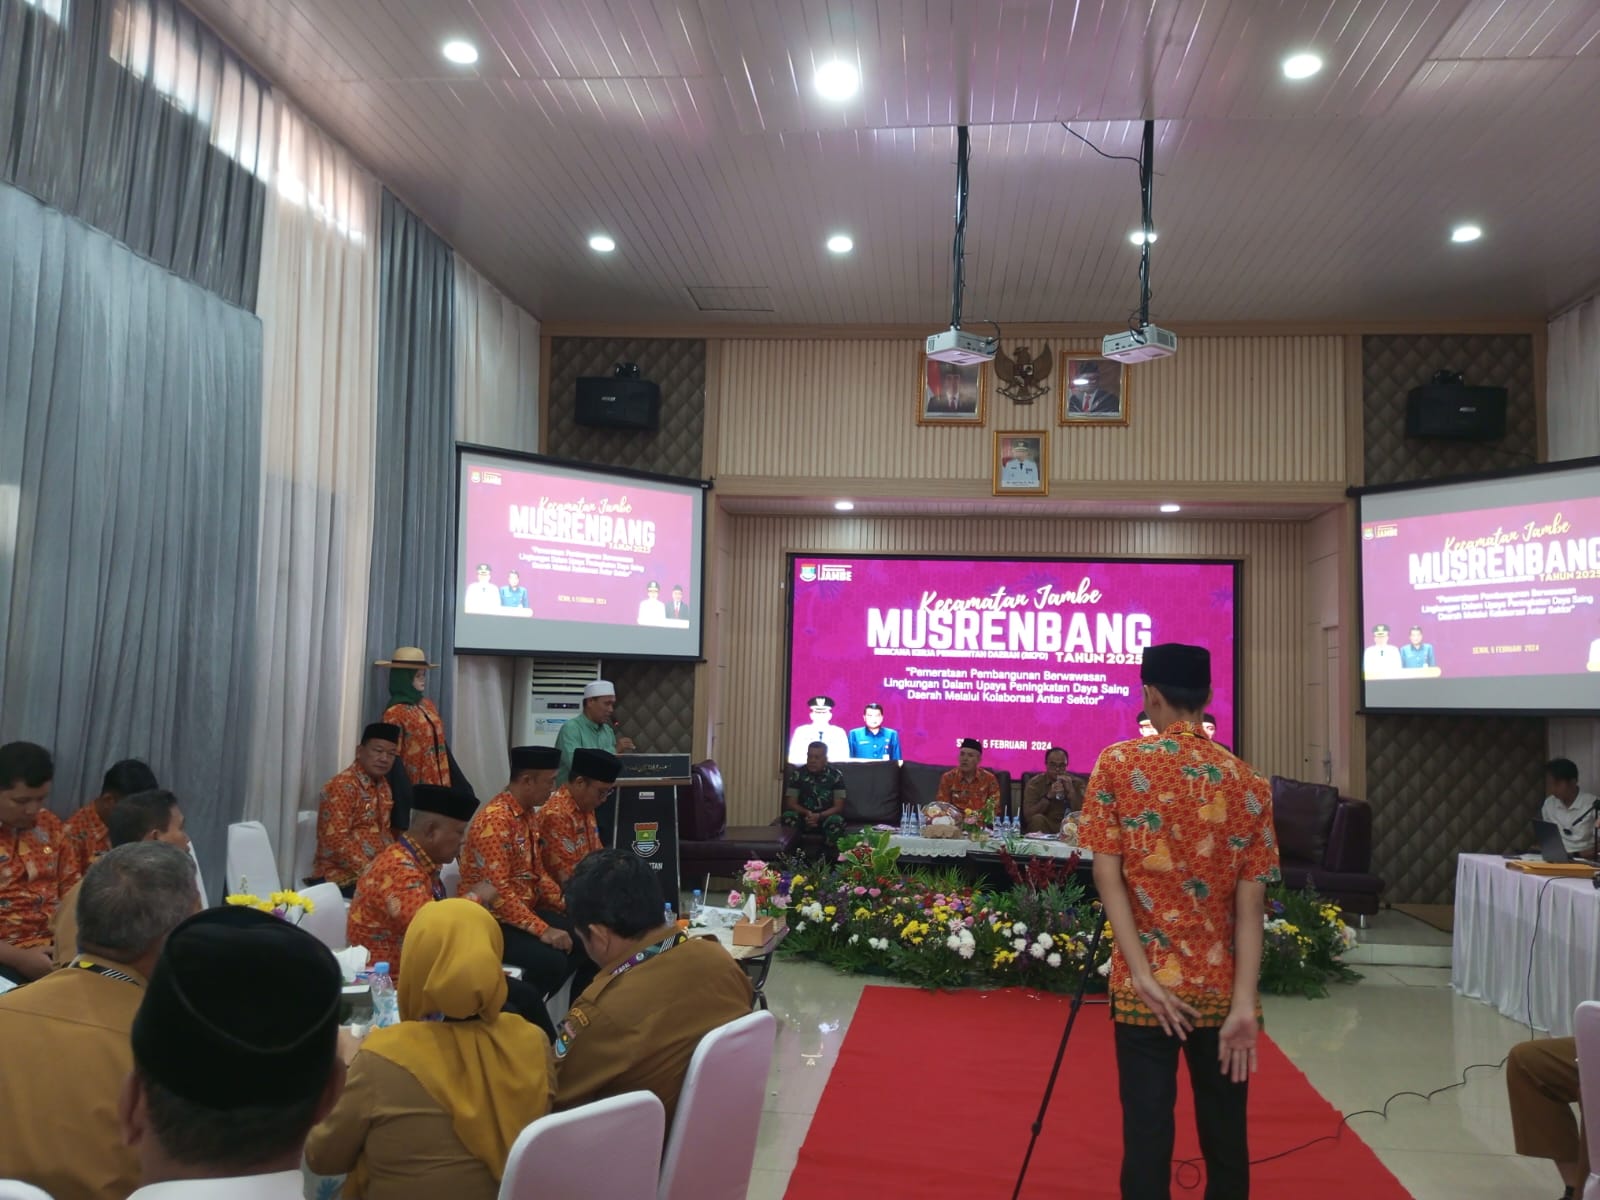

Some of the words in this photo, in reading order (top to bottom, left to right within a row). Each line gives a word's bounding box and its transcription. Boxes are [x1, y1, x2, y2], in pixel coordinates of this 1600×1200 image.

[509, 505, 655, 547] MUSRENBANG
[1522, 513, 1571, 541] Jambe
[1409, 537, 1600, 584] MUSRENBANG
[1539, 570, 1574, 582] TAHUN
[919, 586, 1029, 614] Kecamatan
[1034, 576, 1102, 609] Jambe
[867, 607, 1152, 655] MUSRENBANG
[1055, 652, 1104, 664] TAHUN
[1106, 653, 1143, 665] 2025
[905, 666, 968, 678] "Pemerataan
[970, 668, 1041, 681] Pembangunan
[1043, 670, 1107, 682] Berwawasan
[883, 677, 940, 690] Lingkungan
[942, 679, 973, 690] Dalam
[976, 680, 1007, 692] Upaya
[1009, 682, 1070, 693] Peningkatan
[1073, 683, 1098, 695] Daya
[1101, 684, 1130, 696] Saing
[907, 690, 942, 700] Daerah
[944, 690, 980, 701] Melalui
[982, 692, 1034, 702] Kolaborasi
[1036, 694, 1064, 704] Antar
[1066, 694, 1105, 705] Sektor"
[990, 739, 1027, 750] FEBRUARI
[1031, 741, 1052, 751] 2024
